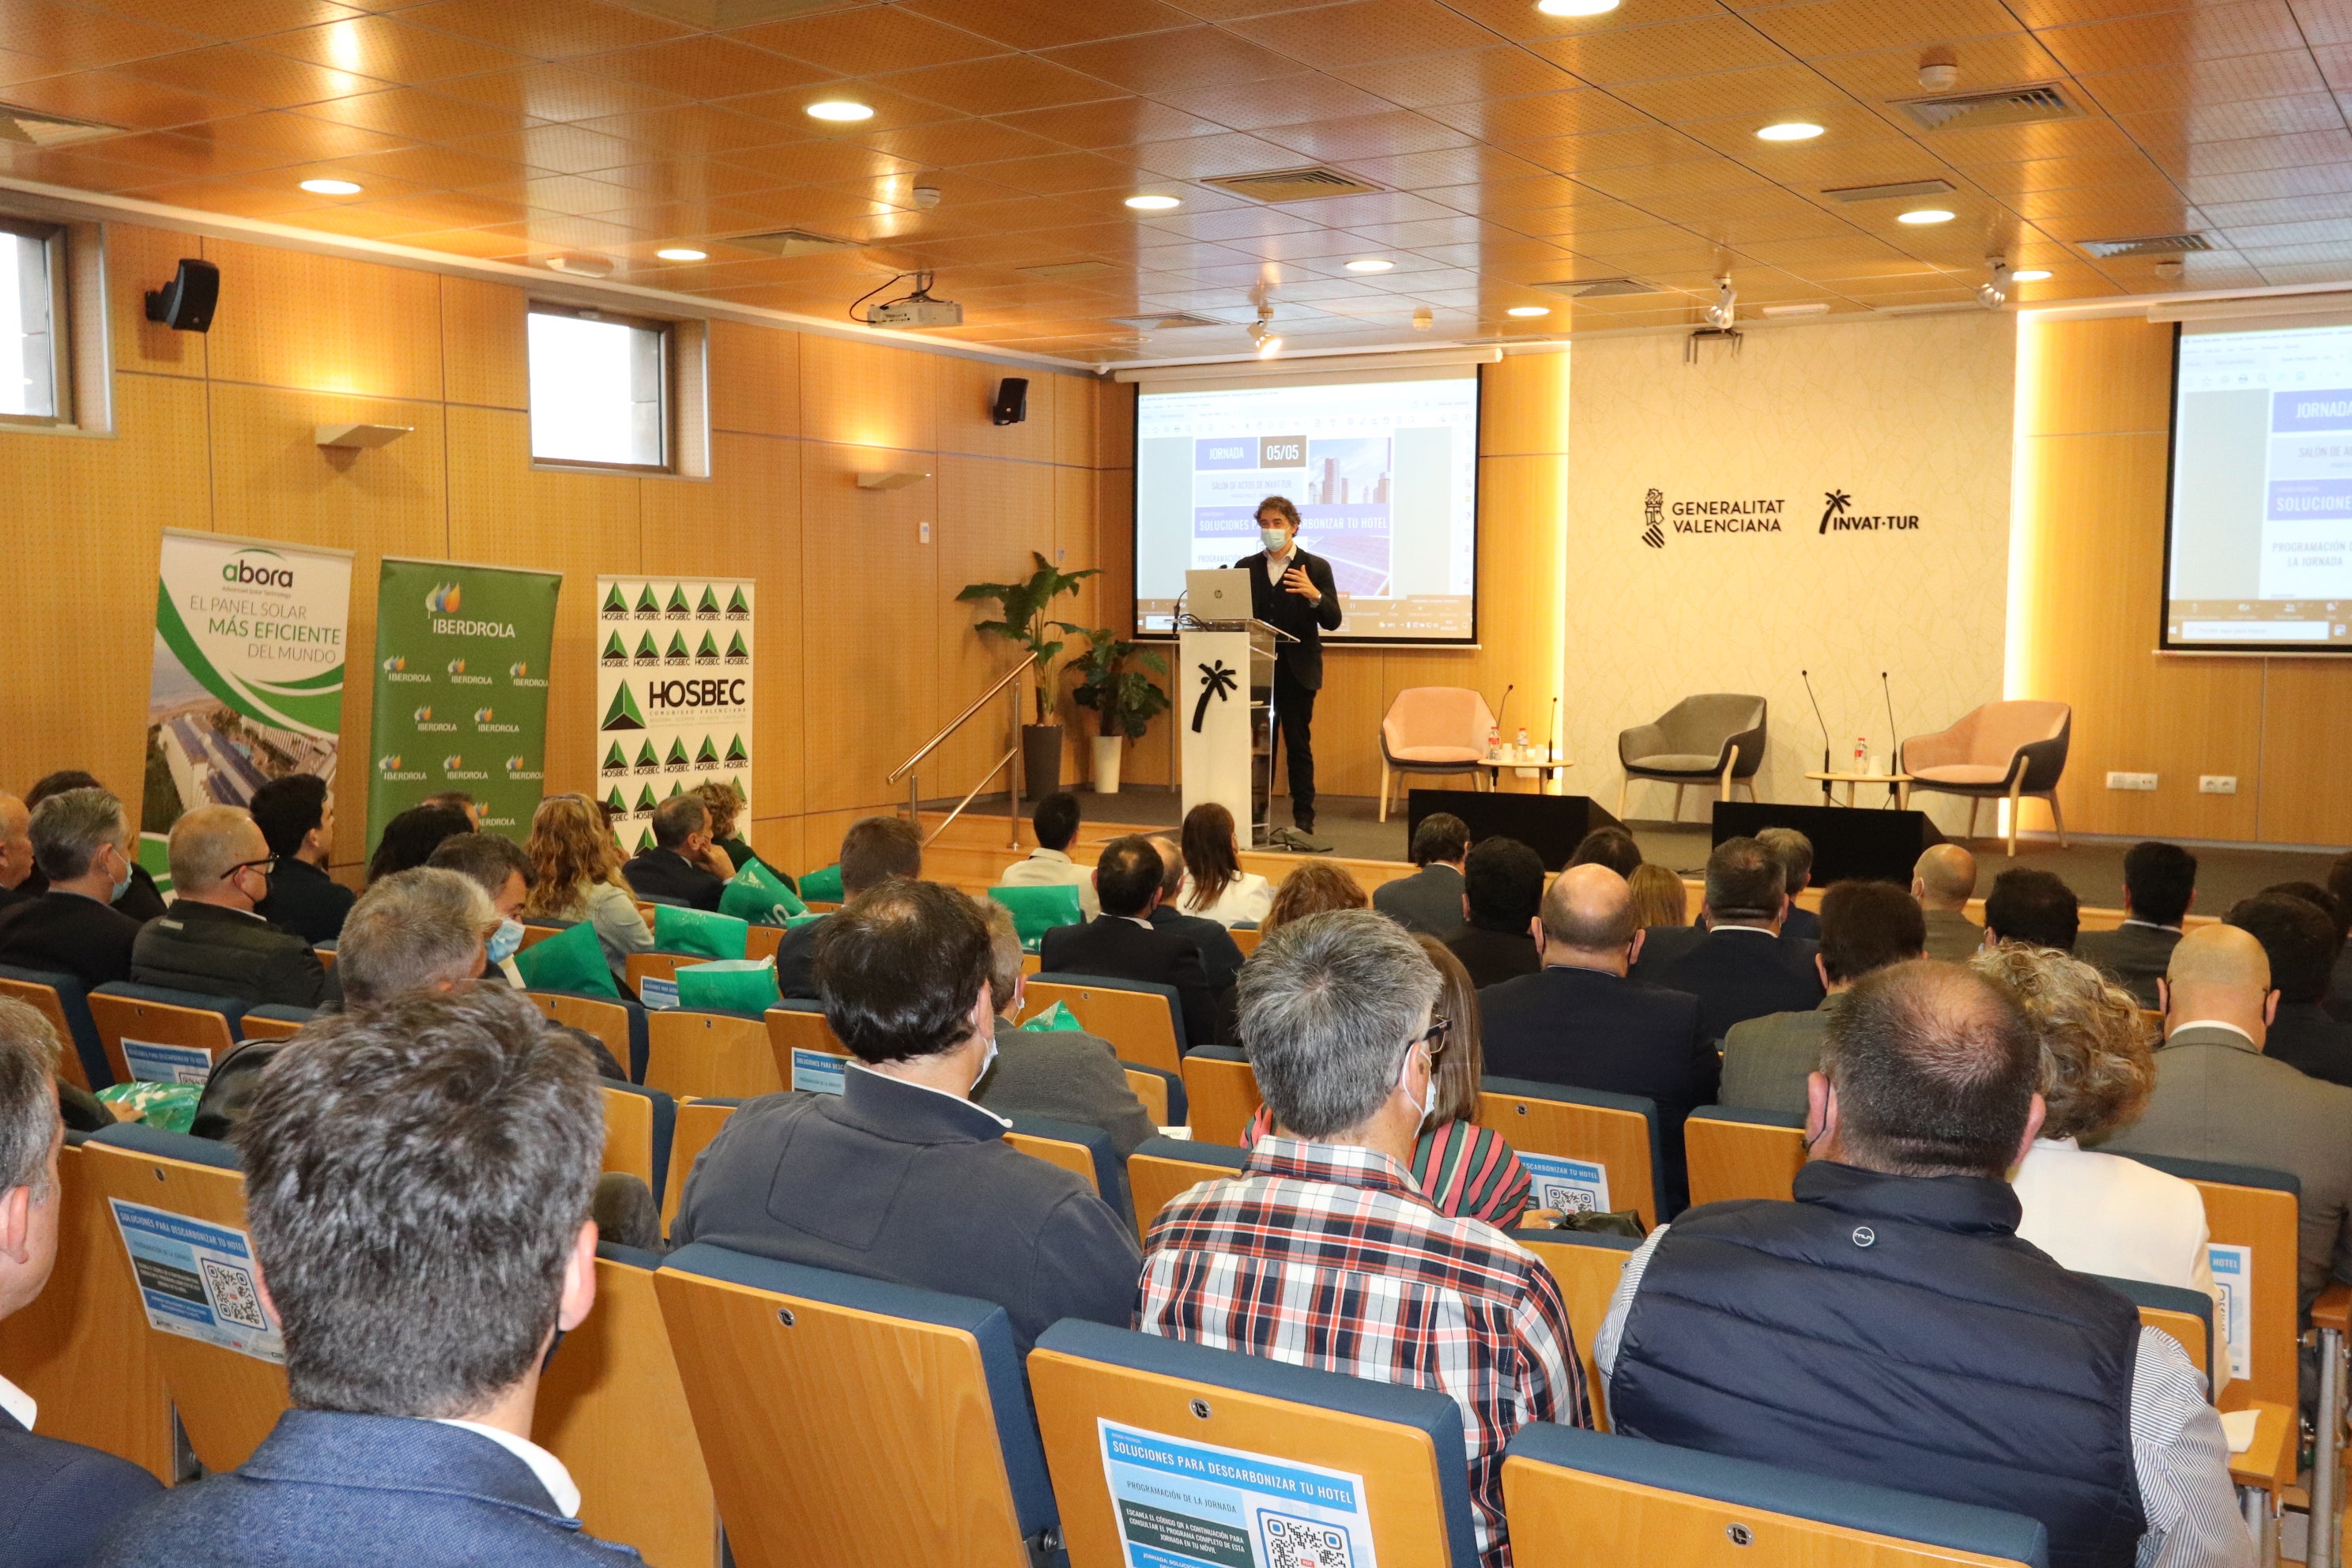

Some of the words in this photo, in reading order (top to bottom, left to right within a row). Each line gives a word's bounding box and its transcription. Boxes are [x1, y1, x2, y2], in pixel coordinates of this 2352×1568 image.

[1208, 447, 1244, 460] JORNADA
[1266, 444, 1299, 461] 05/05
[1672, 499, 1785, 515] GENERALITAT
[2276, 496, 2352, 511] SOLUCIONE
[1200, 519, 1249, 531] SOLUCIONES
[1302, 518, 1344, 530] RBONIZAR
[1348, 518, 1358, 529] TU
[1361, 517, 1388, 529] HOTEL
[1673, 518, 1782, 533] VALENCIANA
[2301, 556, 2343, 567] JORNADA
[222, 560, 293, 588] abora
[190, 594, 207, 611] EL
[211, 597, 258, 616] PANEL
[261, 602, 307, 620] SOLAR
[209, 615, 248, 637] MÁS
[254, 621, 341, 645] EFICIENTE
[432, 619, 515, 638] IBERDROLA
[247, 643, 274, 659] DEL
[278, 646, 336, 664] MUNDO
[634, 658, 661, 667] HOSBEC
[664, 658, 690, 666] HOSBEC
[389, 673, 432, 683] IBERDROLA
[451, 675, 492, 685] IBERDROLA
[649, 679, 745, 708] HOSBEC
[417, 723, 458, 732] IBERDROLA
[478, 724, 519, 733] IBERDROLA
[601, 769, 629, 778] HOSBEC
[634, 767, 660, 775] HOSBEC
[665, 764, 690, 773] HOSBEC
[695, 762, 719, 771] HOSBEC
[384, 771, 427, 781] IBERDROLA
[447, 771, 488, 780] IBERDROLA
[1523, 1163, 1567, 1174] ESCARBONIZAR
[1579, 1170, 1598, 1179] HOTEL
[120, 1212, 155, 1228] SOLUCIONES
[155, 1221, 171, 1233] PARA
[172, 1225, 217, 1246] DESCARBONIZAR
[218, 1238, 226, 1246] TU
[2213, 1258, 2238, 1268] HOTEL
[1112, 1441, 1174, 1465] SOLUCIONES
[1178, 1456, 1205, 1472] PARA
[1208, 1462, 1297, 1492] DESCARBONIZAR
[1299, 1481, 1314, 1495] TU
[1317, 1486, 1353, 1504] HOTEL
[1126, 1480, 1182, 1500] PROGRAMACIÓN
[1183, 1494, 1193, 1503] DE
[1193, 1496, 1203, 1506] LA
[1204, 1498, 1237, 1513] JORNADA
[1126, 1508, 1149, 1521] ESCANEA
[1155, 1515, 1176, 1527] CÓDIGO
[1176, 1521, 1185, 1529] QR
[1189, 1525, 1229, 1540] CONTINUACIÓN
[1229, 1535, 1244, 1544] PARA
[1129, 1517, 1159, 1531] CONSULTAR
[1166, 1526, 1195, 1540] PROGRAMA
[1196, 1534, 1223, 1547] COMPLETO
[1231, 1543, 1245, 1553] ESTA
[1160, 1534, 1183, 1546] JORNADA
[1200, 1543, 1216, 1554] MÓVIL
